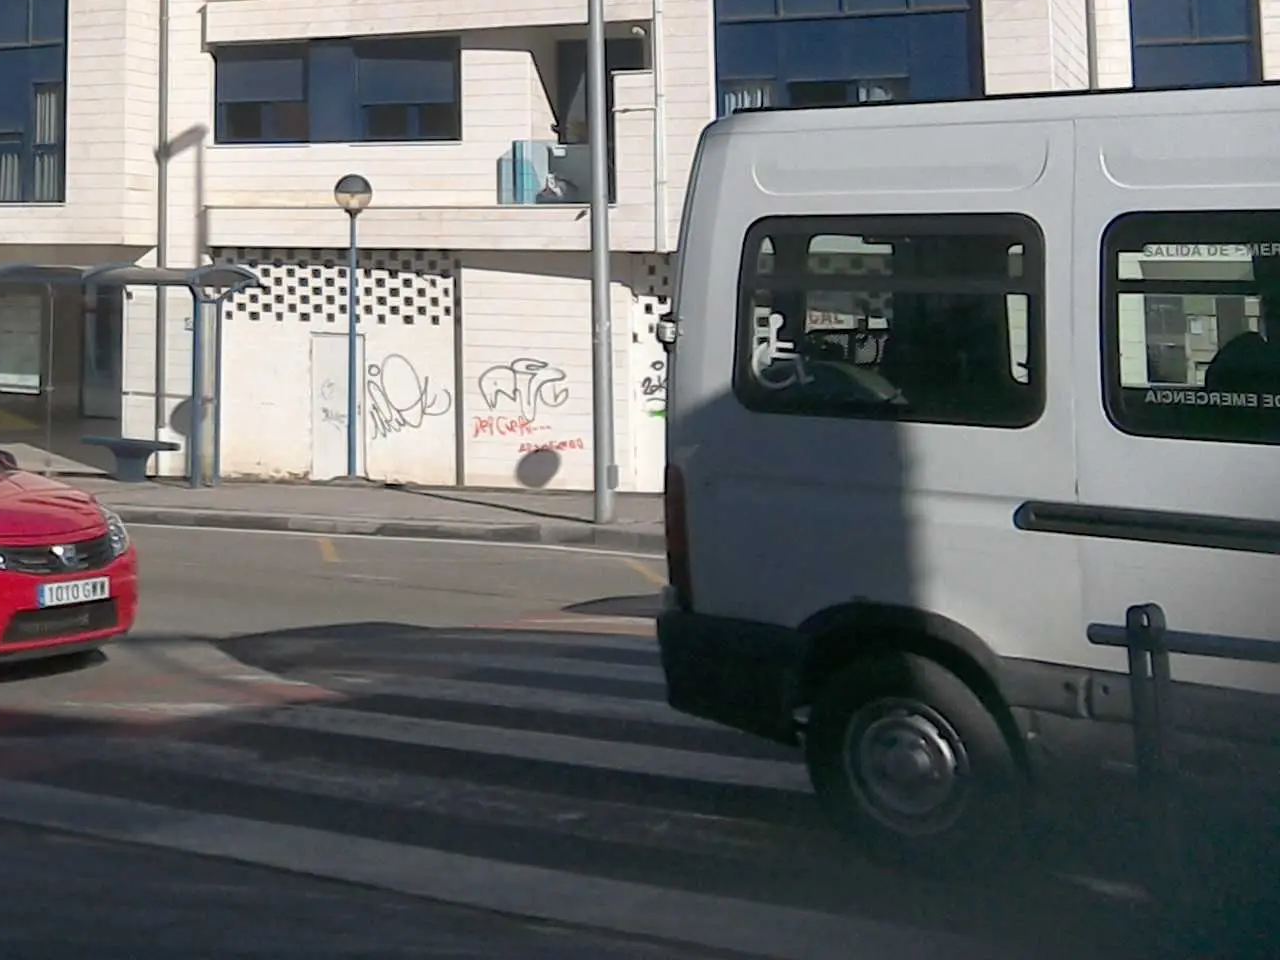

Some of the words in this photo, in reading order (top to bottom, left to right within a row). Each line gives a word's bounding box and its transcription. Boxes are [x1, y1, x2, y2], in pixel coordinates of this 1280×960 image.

[1143, 243, 1202, 258] SALIDA
[1207, 243, 1230, 257] DE
[48, 583, 80, 603] 1010
